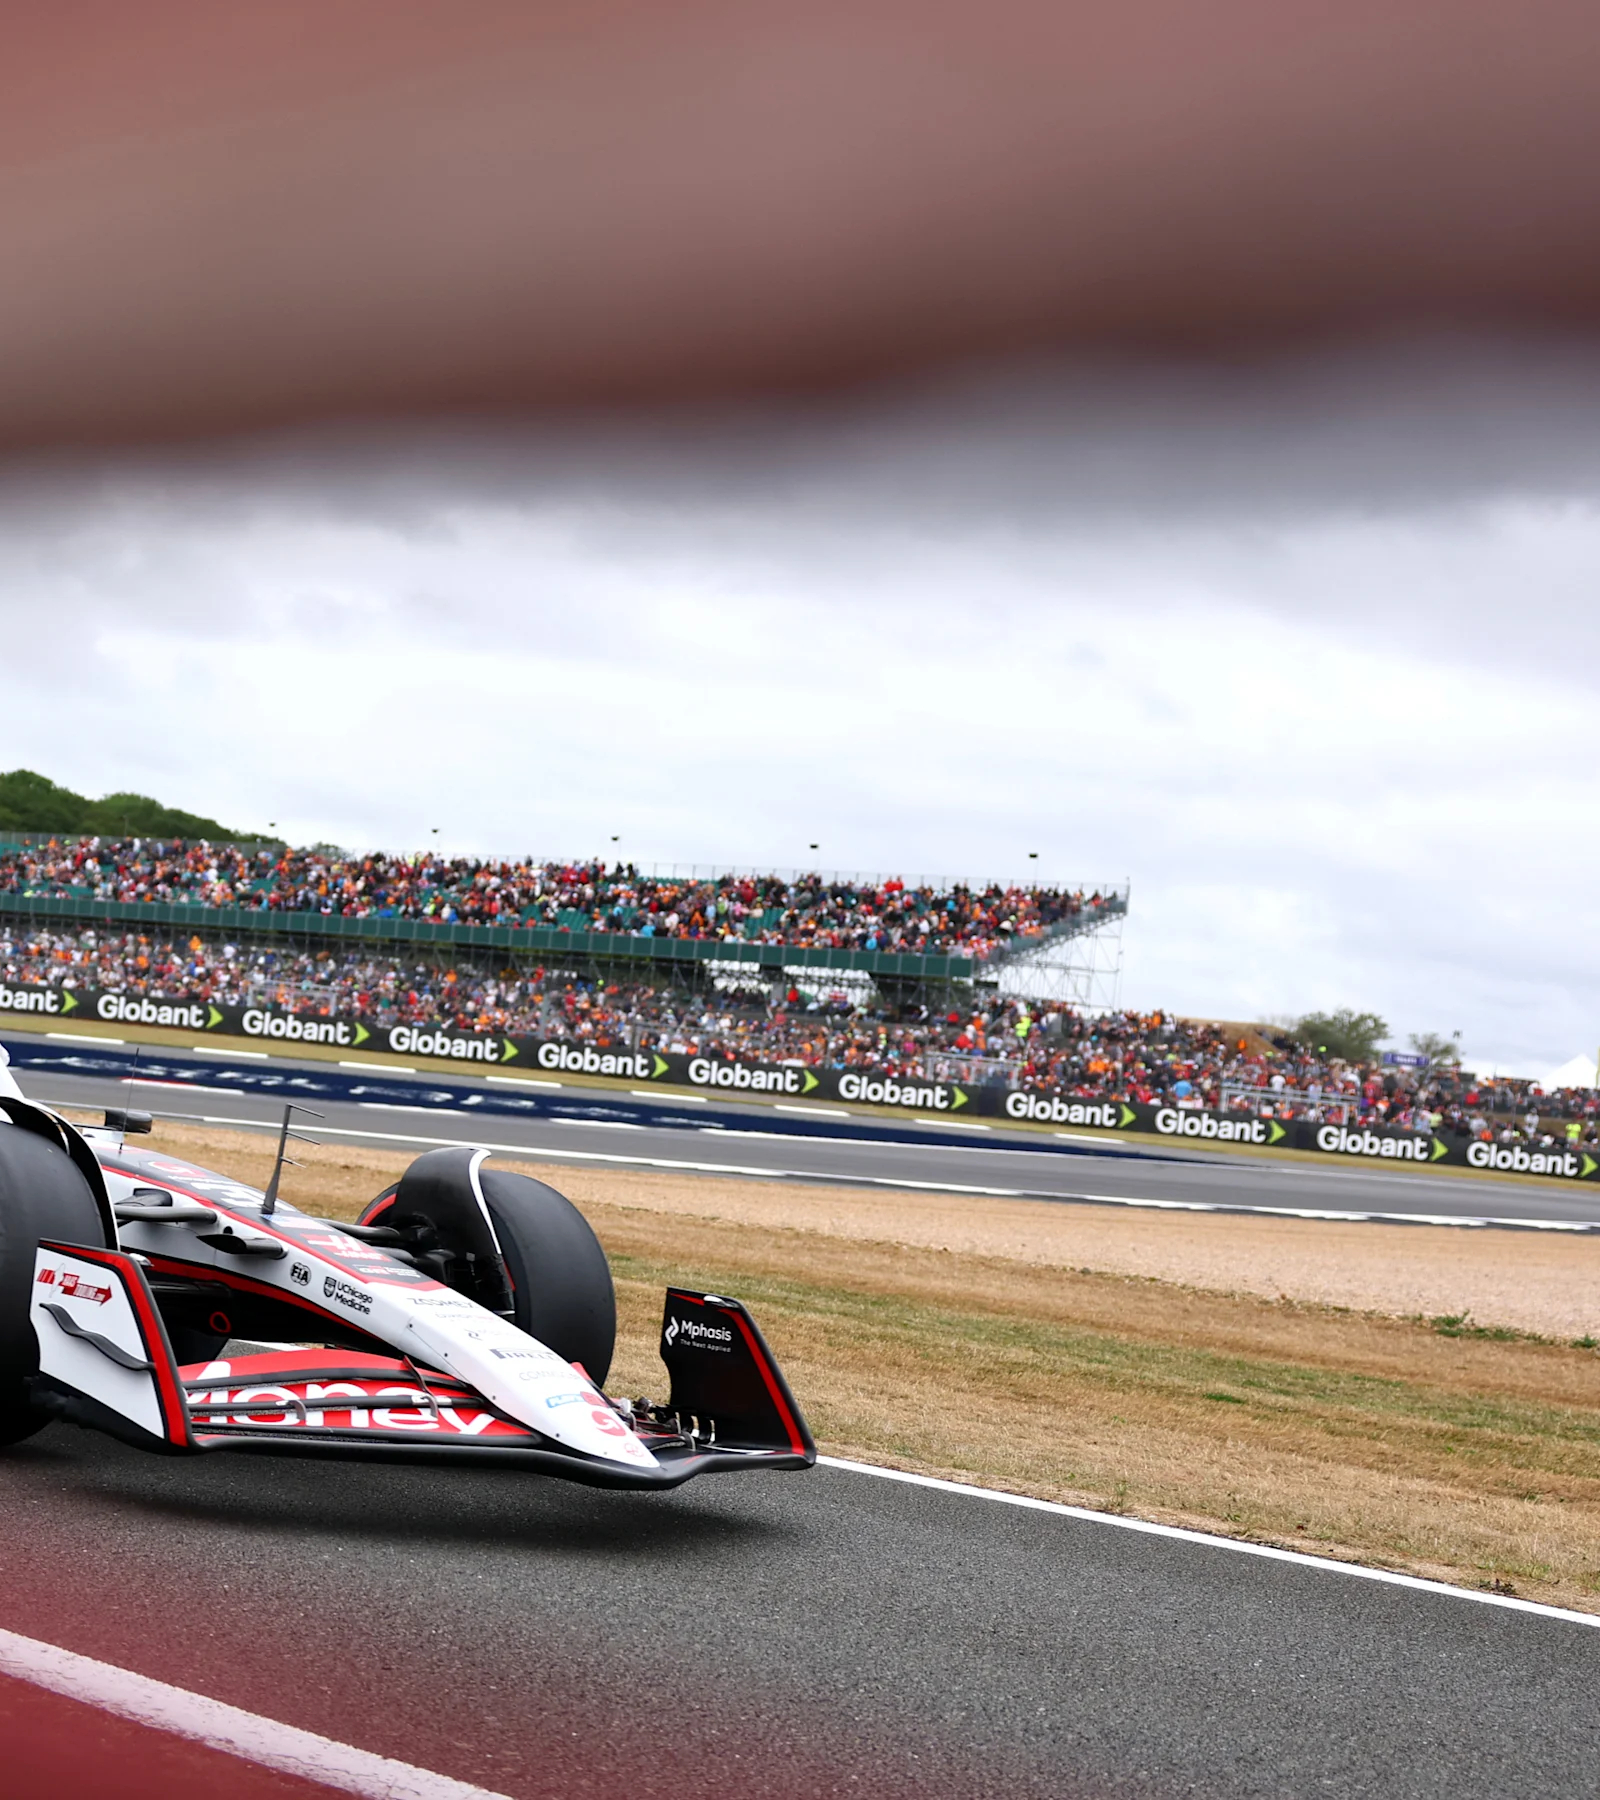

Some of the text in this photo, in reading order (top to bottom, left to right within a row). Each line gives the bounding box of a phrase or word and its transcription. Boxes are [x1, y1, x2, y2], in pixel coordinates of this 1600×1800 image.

[97, 994, 205, 1028] Globant
[242, 1009, 351, 1045] Globant
[388, 1025, 499, 1062] Globant
[537, 1042, 650, 1078] Globant
[688, 1058, 800, 1093] Globant
[838, 1073, 949, 1110] Globant
[1005, 1091, 1117, 1127] Globant
[1154, 1107, 1266, 1143] Globant
[1317, 1125, 1429, 1161] Globant
[1466, 1141, 1578, 1177] Globant
[291, 1265, 309, 1283] FIA
[334, 1292, 370, 1315] Medicine
[337, 1281, 373, 1304] UChicago
[681, 1320, 732, 1341] Mphasis
